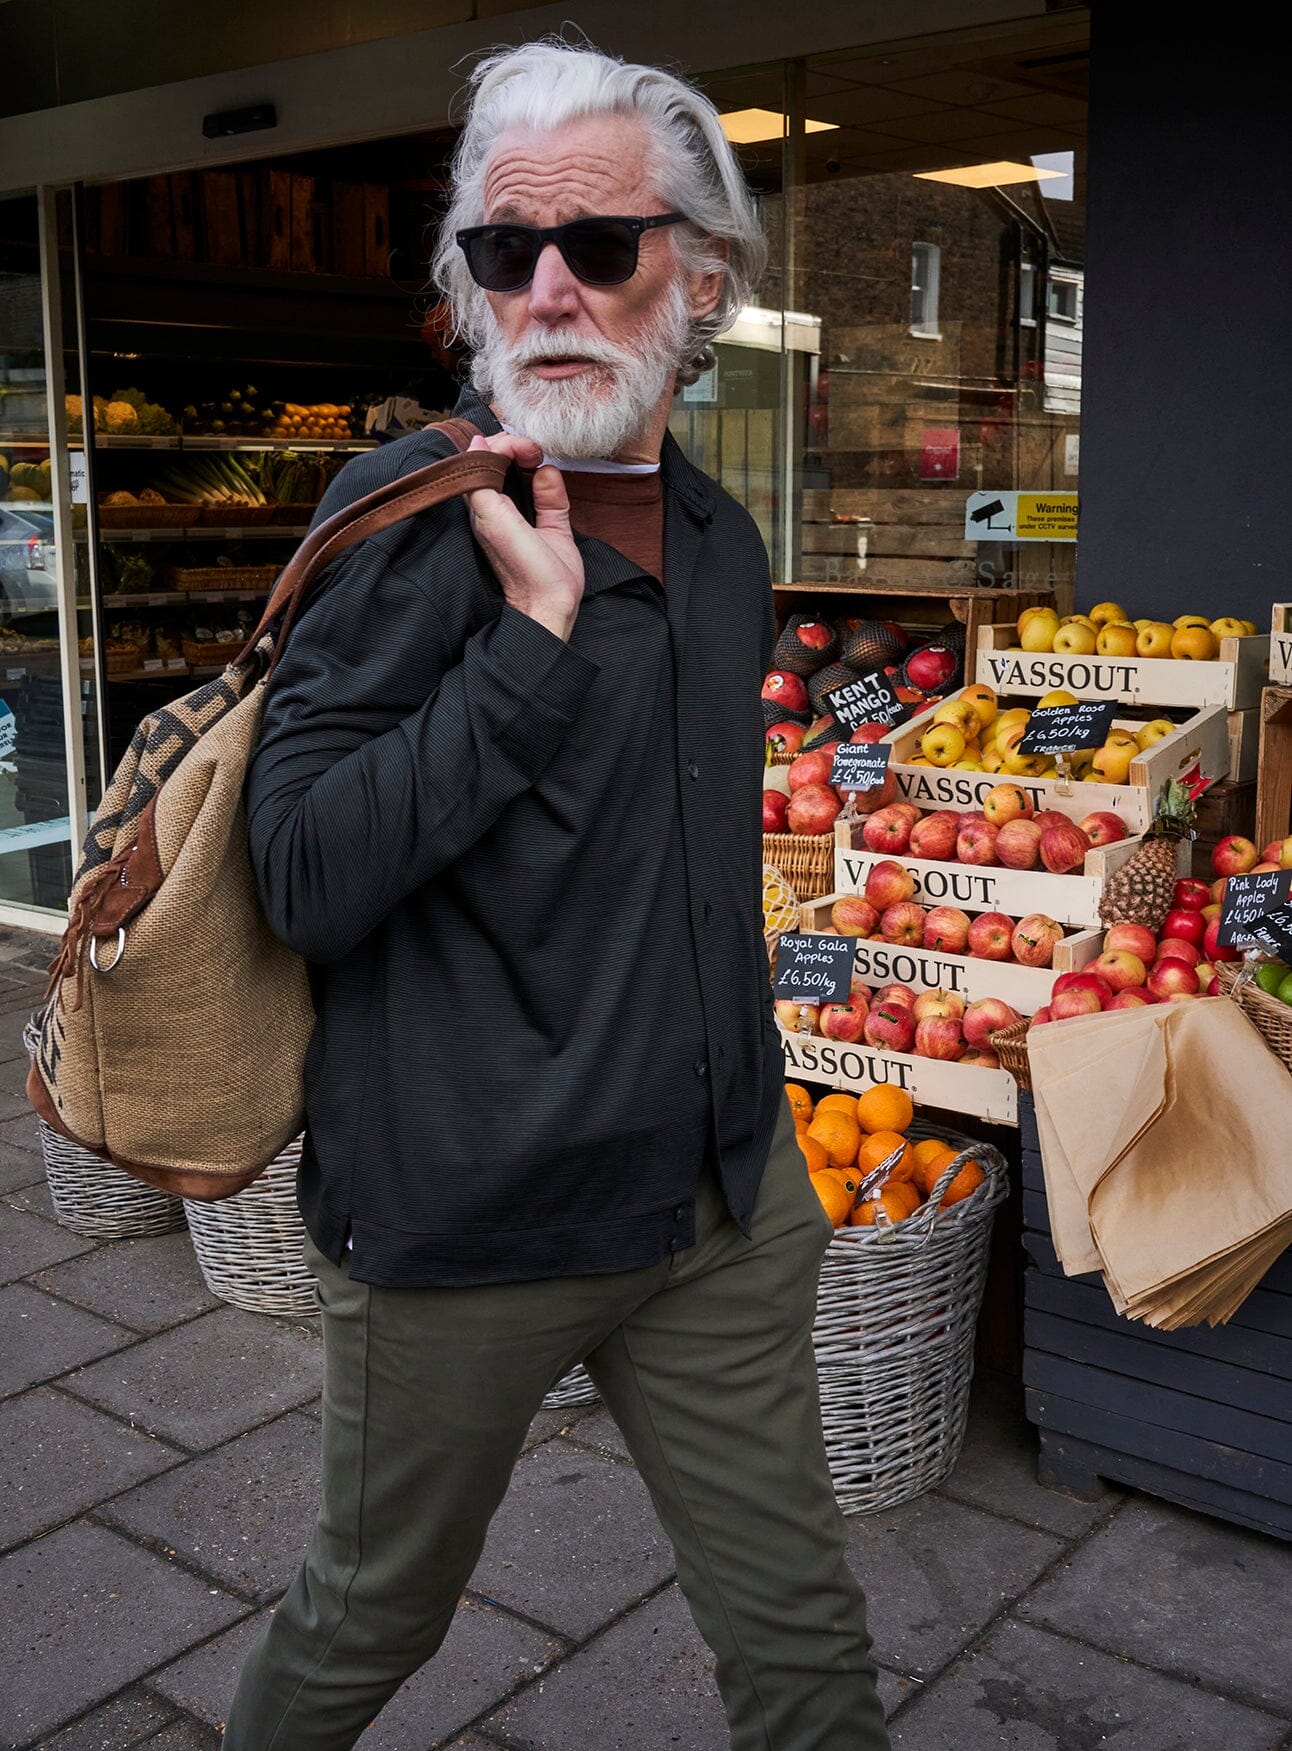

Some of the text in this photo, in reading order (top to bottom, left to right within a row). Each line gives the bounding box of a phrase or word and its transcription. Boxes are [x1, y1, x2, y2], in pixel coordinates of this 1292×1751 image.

[1036, 503, 1078, 515] Warning
[829, 672, 880, 707] KENT
[836, 689, 891, 723] MANGO
[1031, 704, 1106, 717] Golden Rose
[1051, 714, 1093, 725] Apples
[837, 743, 869, 754] Giant
[833, 755, 886, 773] Pomegranate
[895, 773, 1045, 812] VASSOT
[1228, 873, 1279, 895] Pink Lady
[1236, 890, 1265, 907] Apples
[780, 935, 848, 952] Royal Gala
[795, 953, 834, 964] Apples
[784, 1040, 912, 1090] ASSOUT
